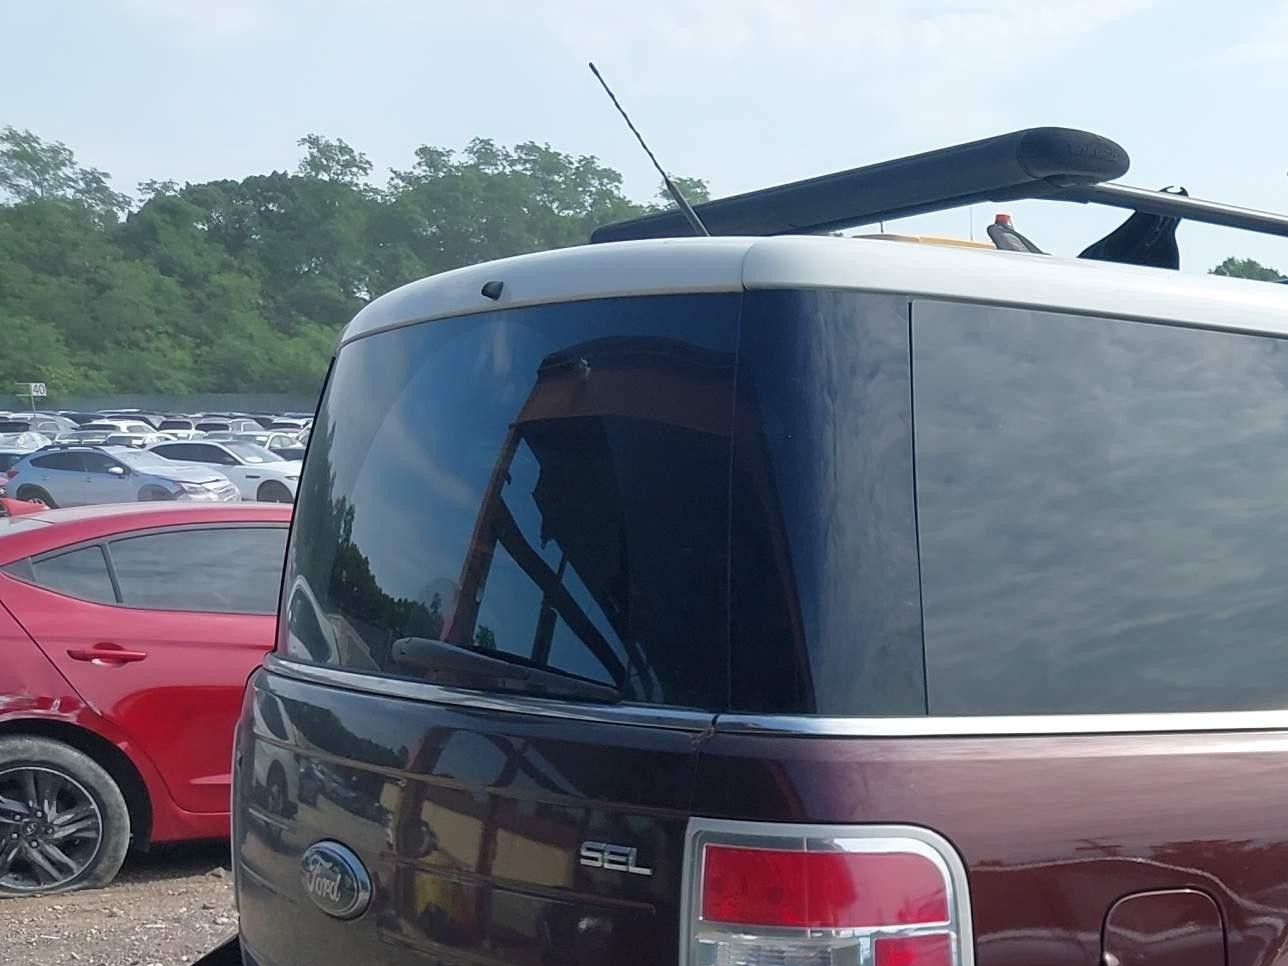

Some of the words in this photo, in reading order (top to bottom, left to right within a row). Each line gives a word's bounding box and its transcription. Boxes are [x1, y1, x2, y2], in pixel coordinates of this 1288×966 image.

[33, 384, 45, 395] 40
[580, 841, 653, 876] SEL
[306, 854, 342, 902] Ford
